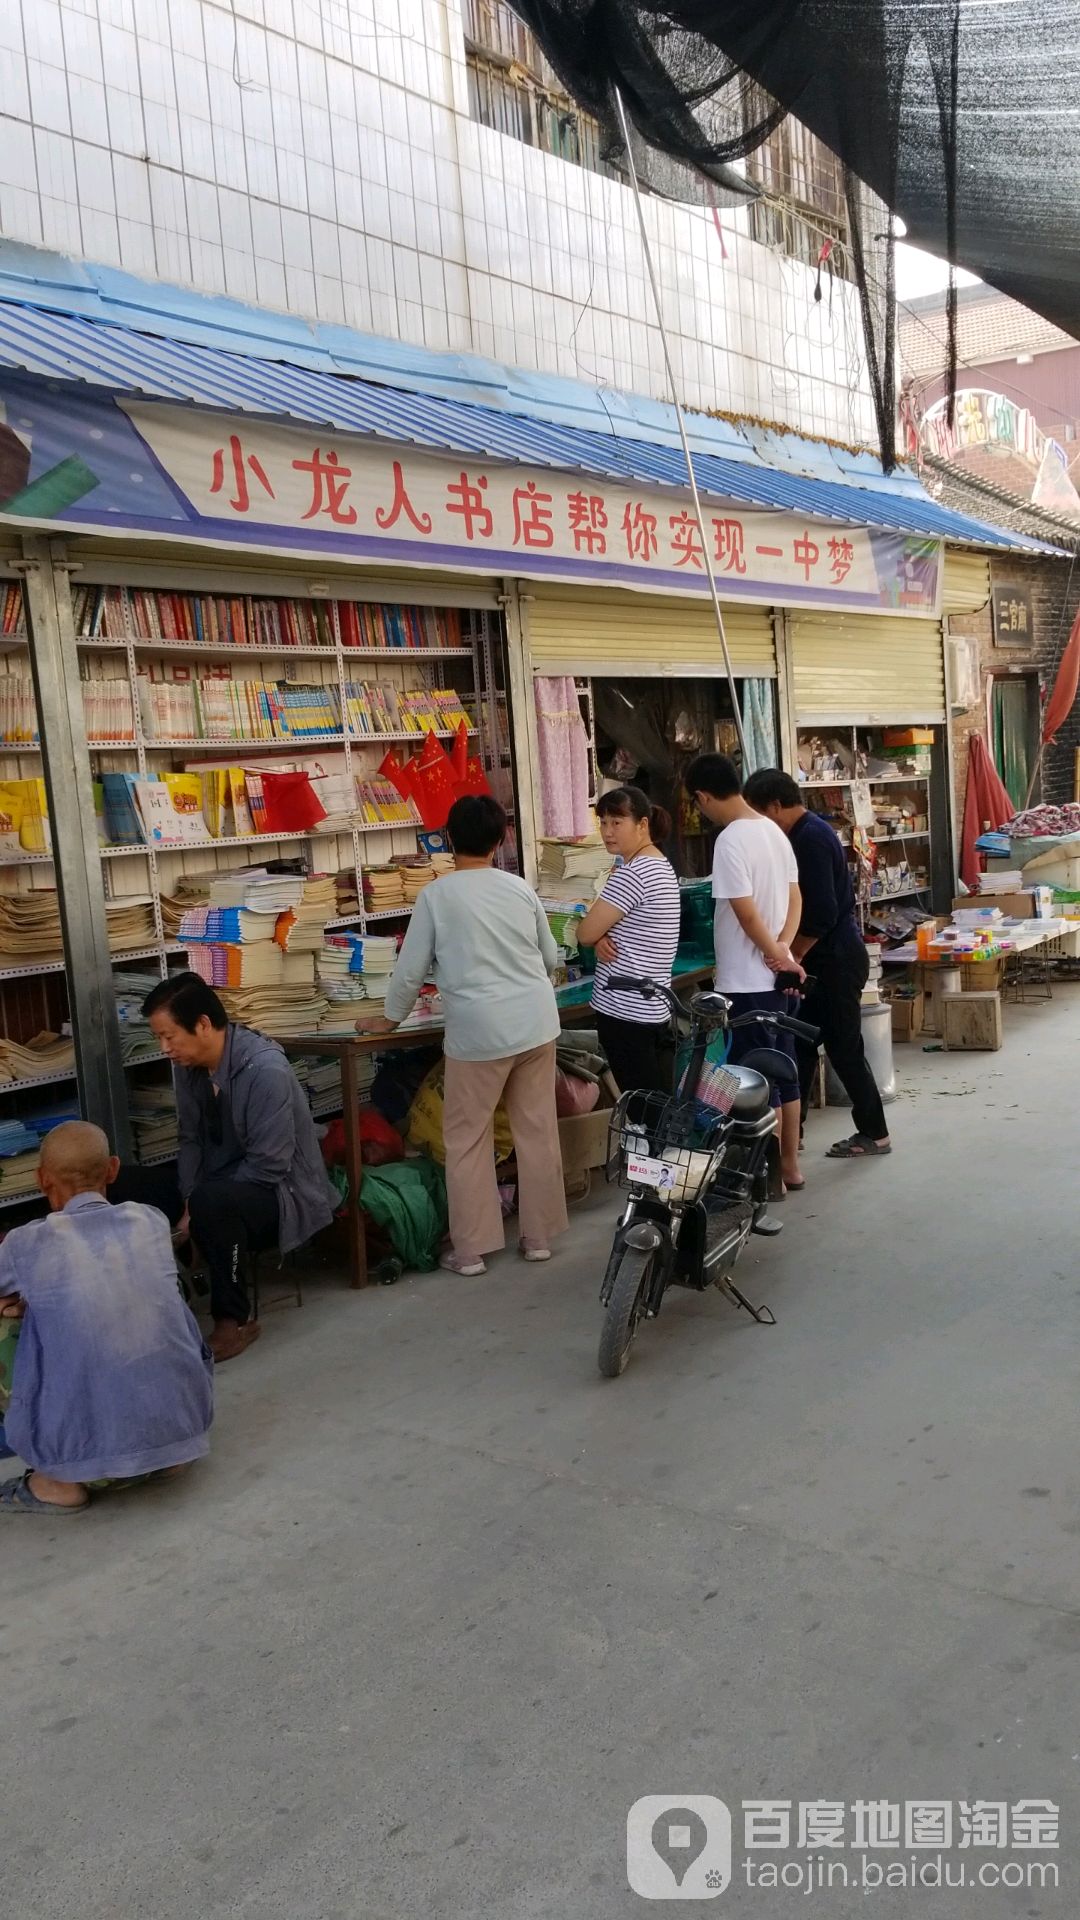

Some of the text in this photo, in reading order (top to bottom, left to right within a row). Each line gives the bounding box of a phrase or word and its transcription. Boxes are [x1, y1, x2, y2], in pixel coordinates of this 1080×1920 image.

[209, 434, 855, 585] 小龙人书店帮你实现一中梦
